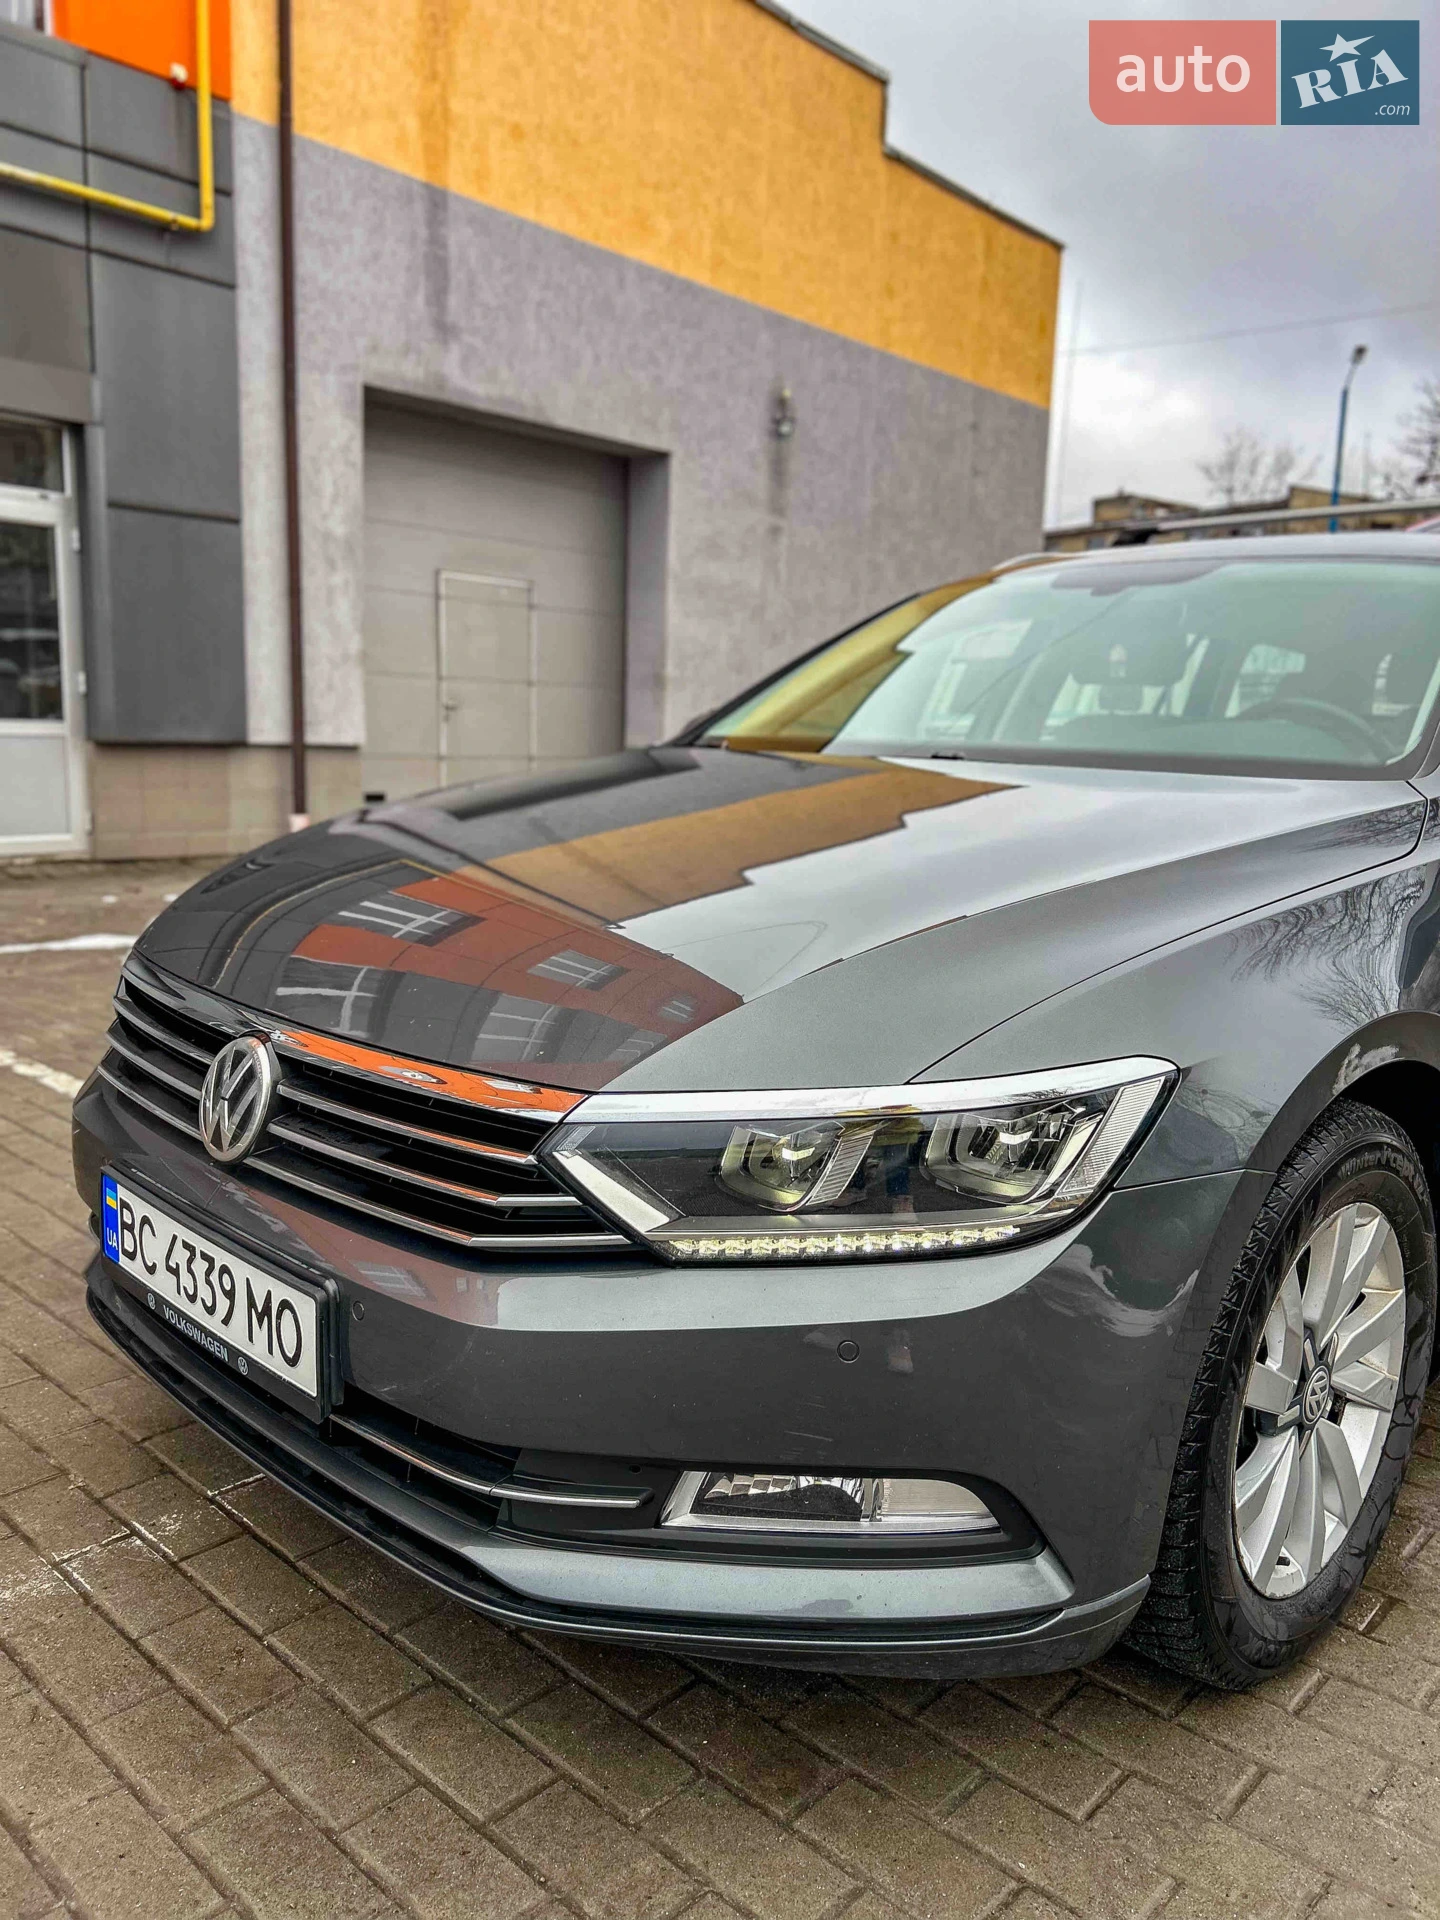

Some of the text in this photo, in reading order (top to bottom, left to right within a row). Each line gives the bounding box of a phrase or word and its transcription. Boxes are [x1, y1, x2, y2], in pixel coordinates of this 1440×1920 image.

[106, 1227, 118, 1250] UA
[119, 1197, 303, 1368] BC 4339 MO
[163, 1304, 229, 1362] VOLKSWAGEN
